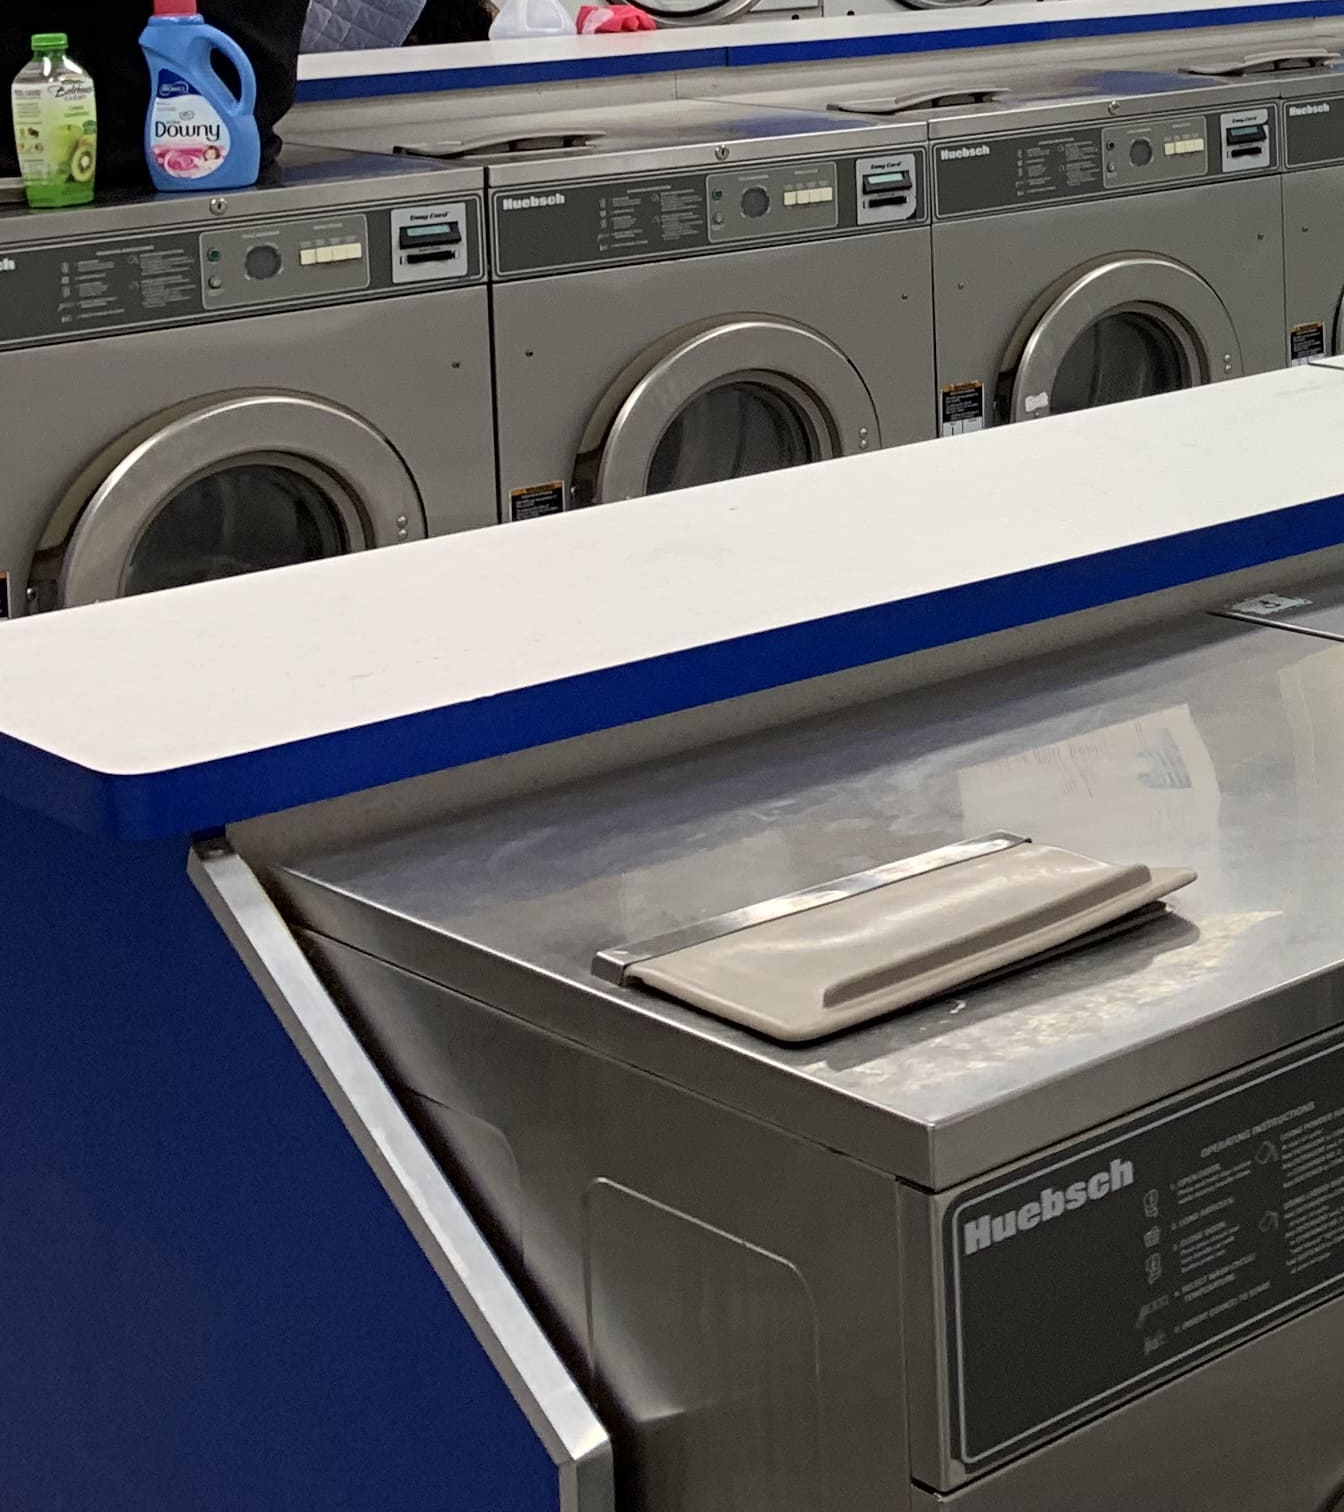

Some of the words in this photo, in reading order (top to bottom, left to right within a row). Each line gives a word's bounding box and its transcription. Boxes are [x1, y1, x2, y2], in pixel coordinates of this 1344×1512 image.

[1287, 101, 1330, 117] Huebsch
[154, 119, 221, 144] Downy
[940, 143, 990, 160] Huebsch
[503, 192, 565, 210] Huebsch
[963, 1157, 1135, 1256] Huebsch
